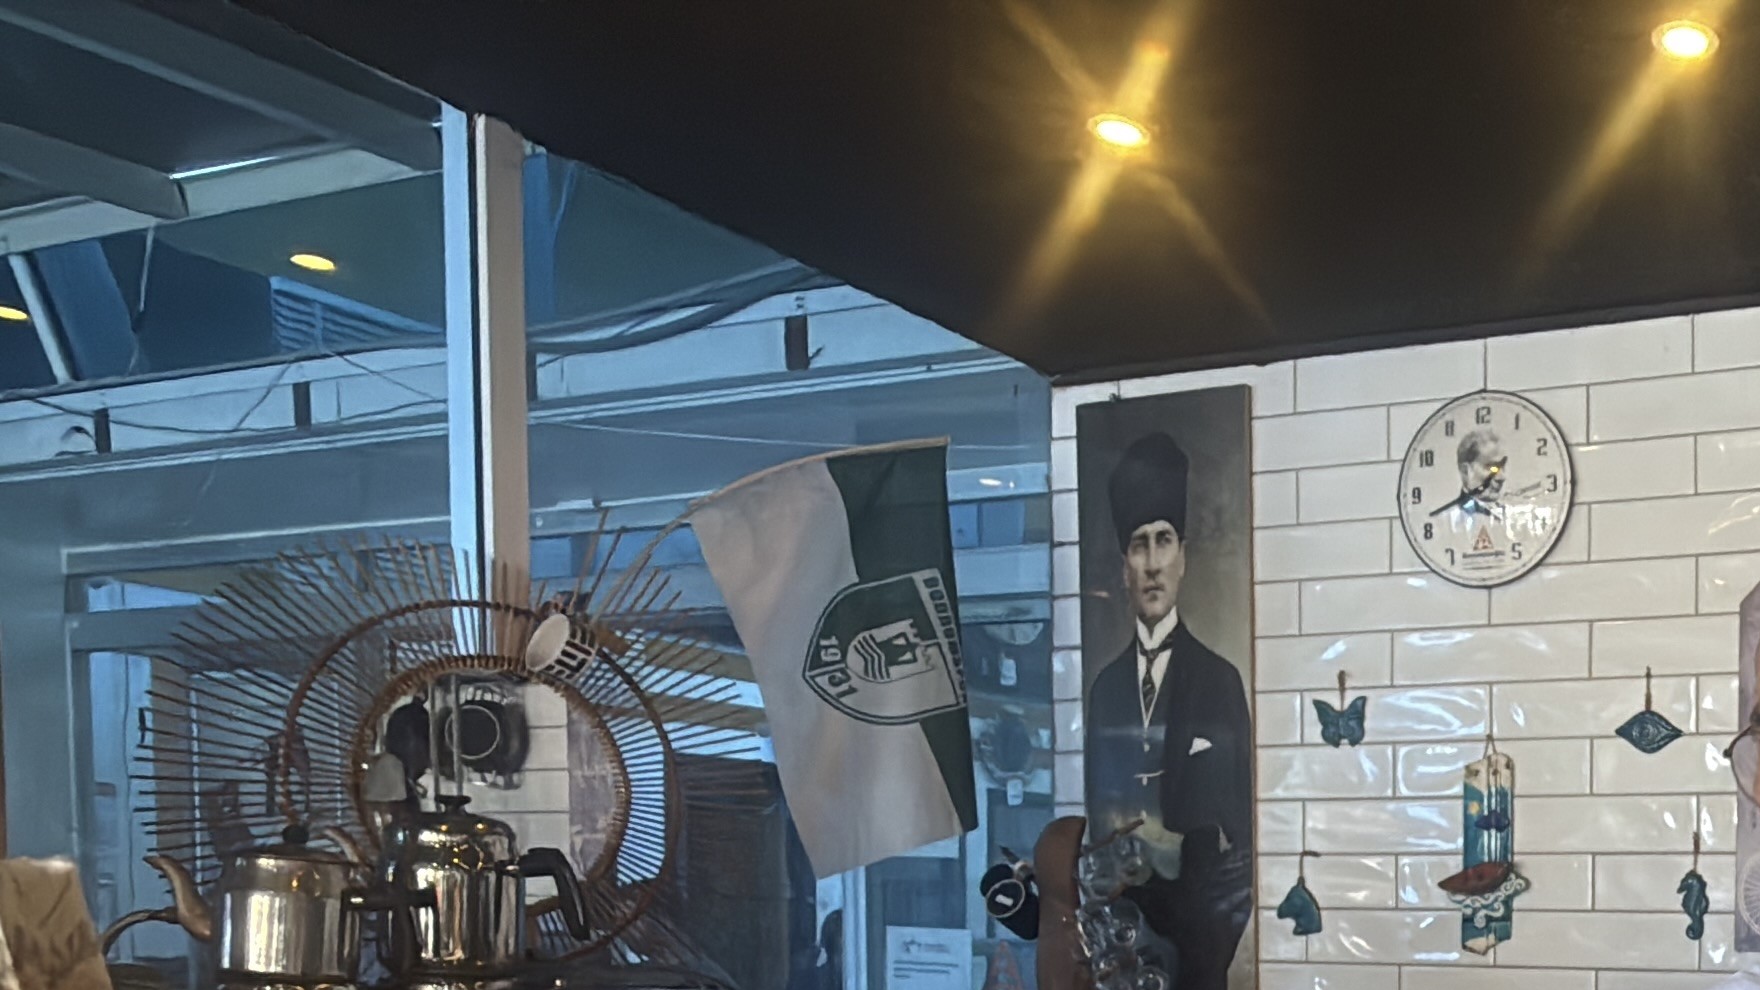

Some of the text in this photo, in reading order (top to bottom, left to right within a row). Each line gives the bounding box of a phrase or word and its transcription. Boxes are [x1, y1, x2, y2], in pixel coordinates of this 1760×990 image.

[1475, 406, 1491, 425] 12
[1513, 413, 1520, 430] 1
[1536, 438, 1548, 456] 2
[1419, 450, 1434, 468] 10
[1546, 474, 1558, 492] 3
[1411, 487, 1422, 504] 9
[1423, 522, 1434, 540] 8
[1444, 548, 1455, 566] 7
[1511, 543, 1522, 560] 5
[819, 635, 842, 663] 19
